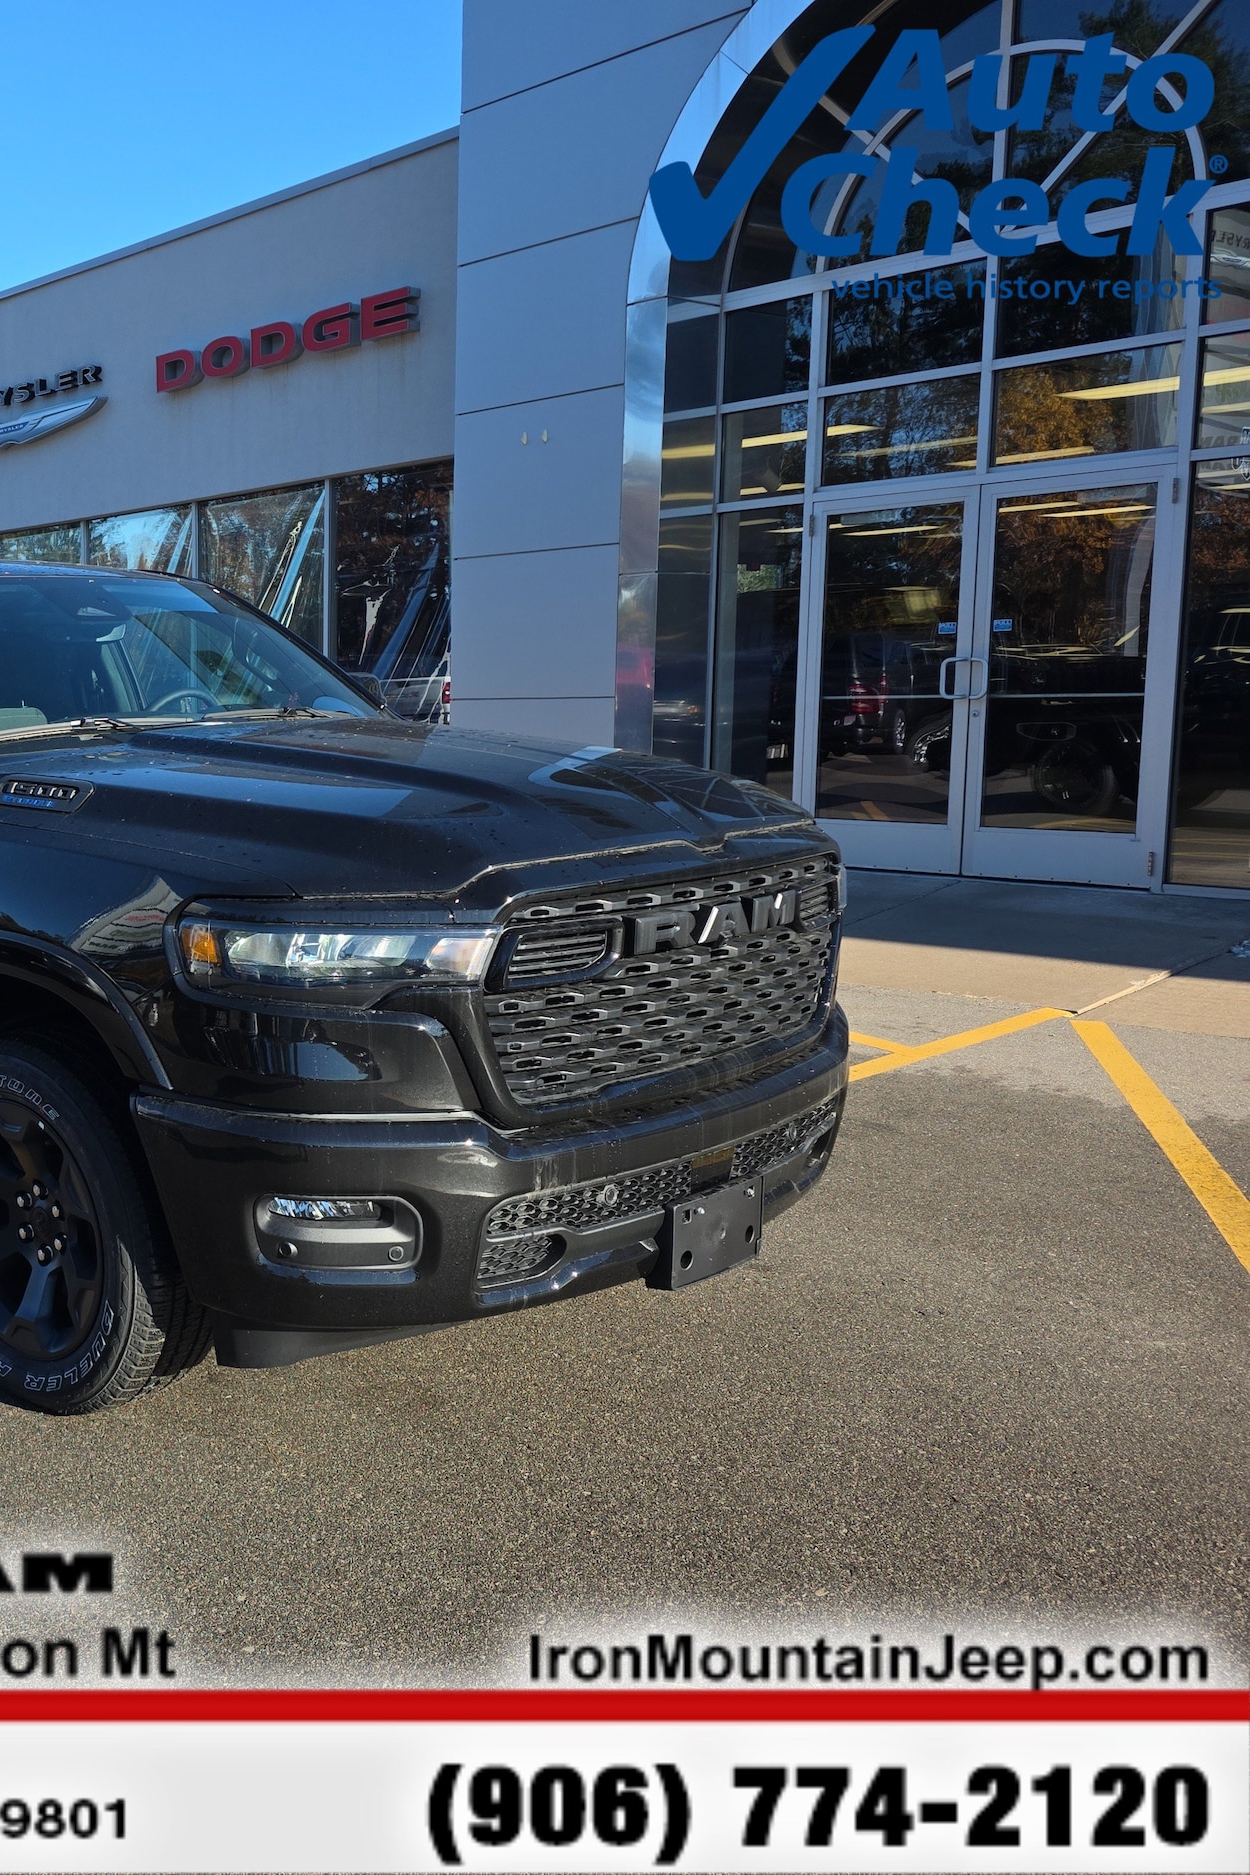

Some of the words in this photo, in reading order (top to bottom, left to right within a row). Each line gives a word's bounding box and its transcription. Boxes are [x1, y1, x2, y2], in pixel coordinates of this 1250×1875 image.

[156, 286, 421, 393] DODGE
[5, 781, 78, 799] 1500
[626, 887, 798, 956] RAM
[24, 1300, 114, 1392] DUELER
